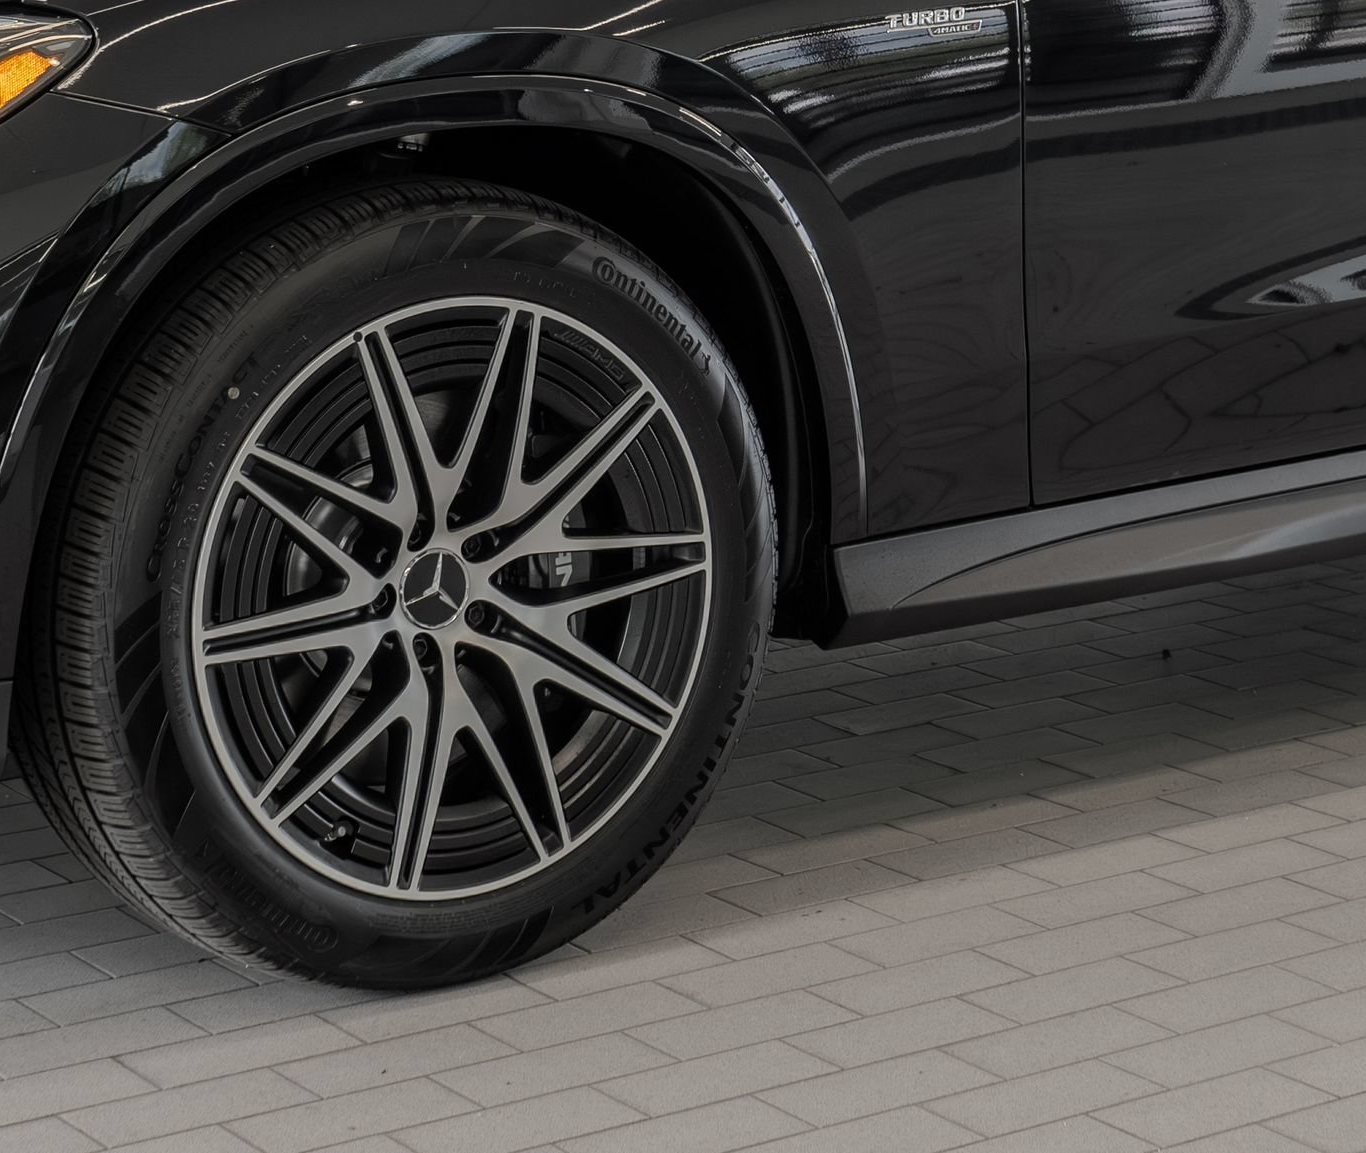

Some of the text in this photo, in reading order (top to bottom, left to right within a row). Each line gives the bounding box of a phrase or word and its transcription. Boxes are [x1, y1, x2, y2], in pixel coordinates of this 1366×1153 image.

[885, 7, 965, 29] TURBO
[591, 255, 703, 361] Continental
[571, 621, 761, 915] CONTINENTAL
